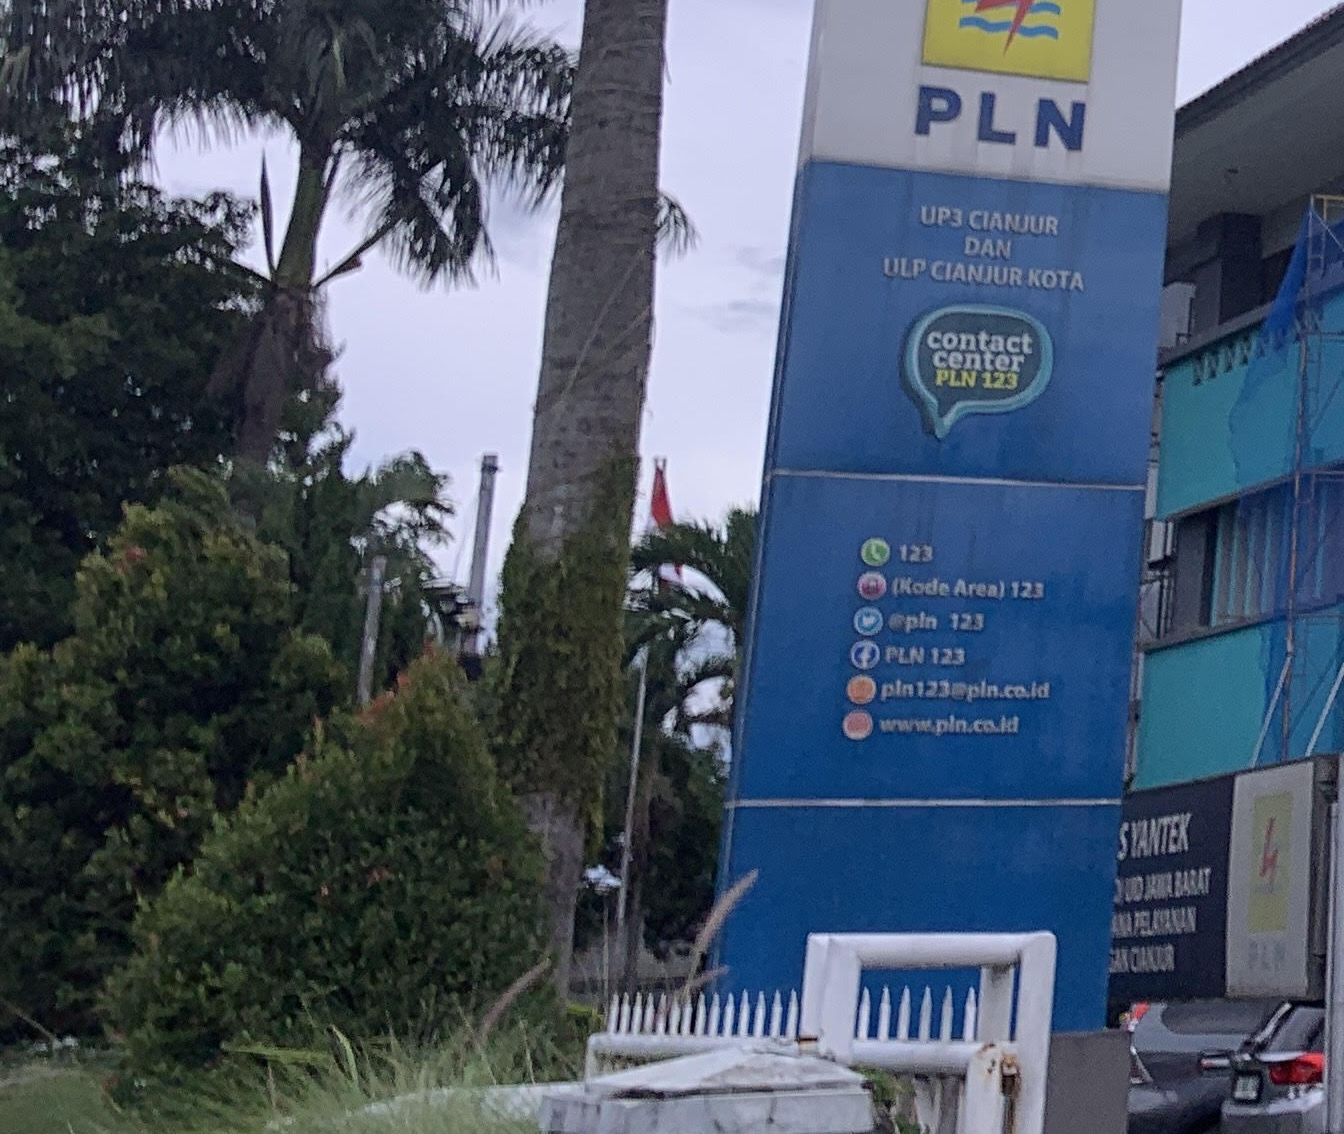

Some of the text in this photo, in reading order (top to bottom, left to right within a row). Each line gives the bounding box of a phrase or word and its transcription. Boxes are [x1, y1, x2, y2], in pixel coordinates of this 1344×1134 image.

[913, 84, 1087, 152] PLN
[920, 204, 1059, 236] UP3 CIANJUR
[963, 235, 1012, 260] DAN
[883, 256, 1085, 292] ULP CIANJUR KOTA
[926, 328, 1033, 355] contact
[931, 350, 1026, 373] center
[935, 368, 1019, 391] PLN 123
[899, 543, 934, 563] 123
[891, 576, 1045, 601] (Kode Area) 123
[951, 612, 986, 632] 123
[884, 645, 966, 666] PLN 123
[880, 678, 1051, 703] pln123@pln.co.id
[878, 715, 1020, 737] www.pln.co.id
[1130, 811, 1193, 859] YANTEK
